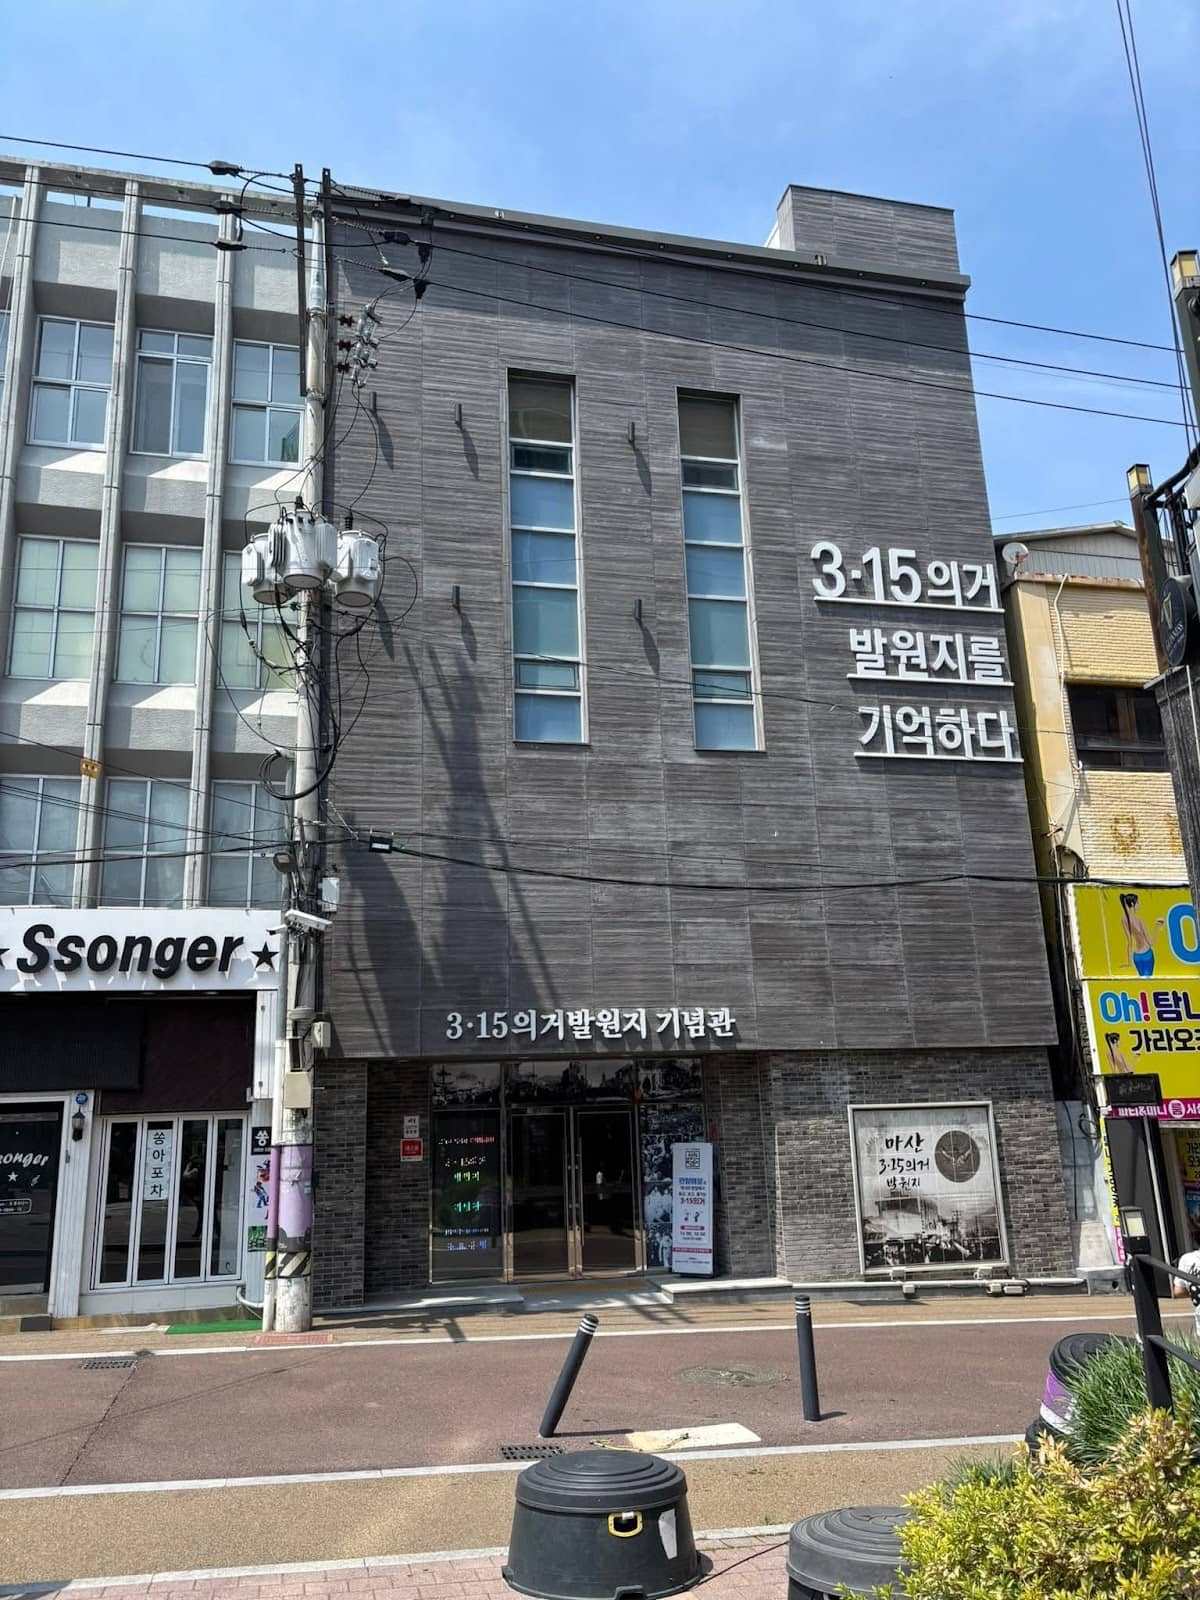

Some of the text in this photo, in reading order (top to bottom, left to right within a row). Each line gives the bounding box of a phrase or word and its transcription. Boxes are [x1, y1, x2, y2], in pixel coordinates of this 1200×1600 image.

[849, 628, 1005, 682] 발원지를
[858, 704, 1014, 760] 기억하다
[17, 923, 244, 978] Ssonger
[656, 1007, 737, 1039] 기념관
[1100, 991, 1150, 1023] Oh!
[1129, 1028, 1200, 1052] 가라오
[885, 1132, 925, 1153] 마산
[149, 1131, 167, 1198] 쏭아포차
